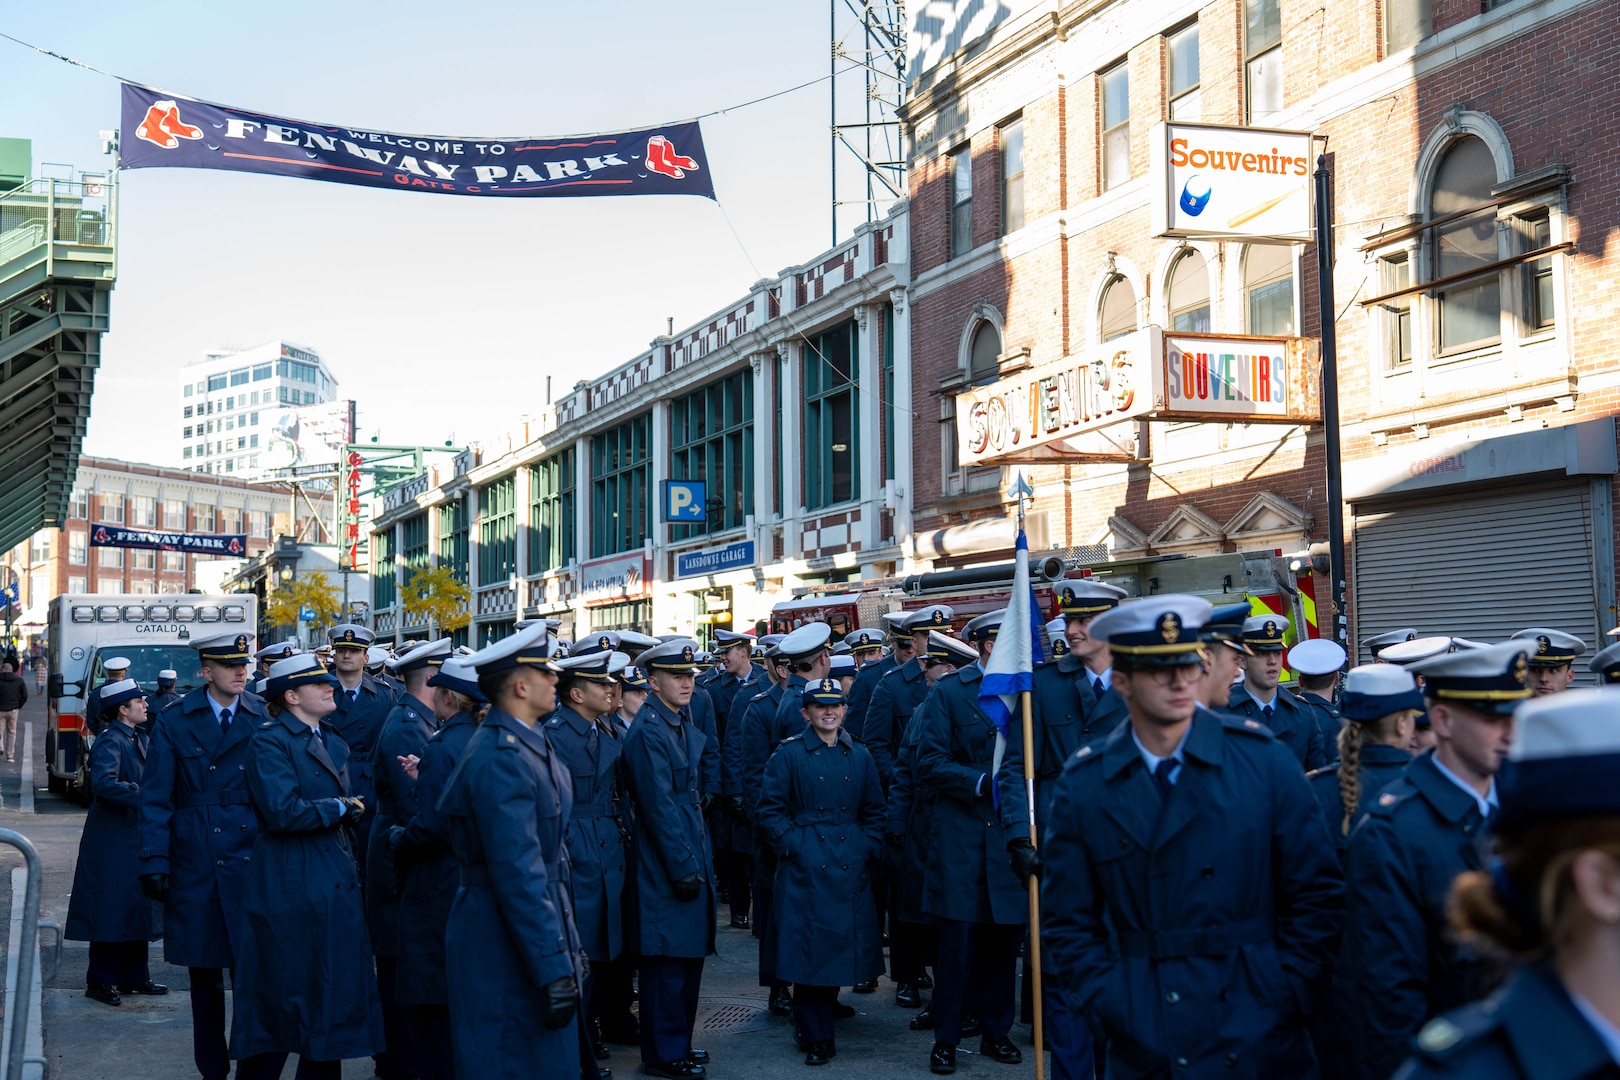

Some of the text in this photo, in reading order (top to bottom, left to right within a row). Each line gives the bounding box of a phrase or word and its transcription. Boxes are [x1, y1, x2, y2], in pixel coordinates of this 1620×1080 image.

[224, 118, 629, 183] FENWAY PARK
[347, 130, 505, 155] WELCOME TO
[1170, 138, 1308, 177] Souvenirs
[394, 173, 481, 193] GATE C
[1168, 350, 1285, 404] SOUVENIRS
[1409, 452, 1465, 477] CORNELL
[347, 452, 363, 514] GATE
[670, 486, 692, 517] P
[116, 531, 180, 545] FENWAY
[183, 537, 225, 549] PARK
[685, 553, 720, 570] LANSDOWNE
[721, 547, 746, 563] GARAGE
[135, 624, 187, 633] CATALDO
